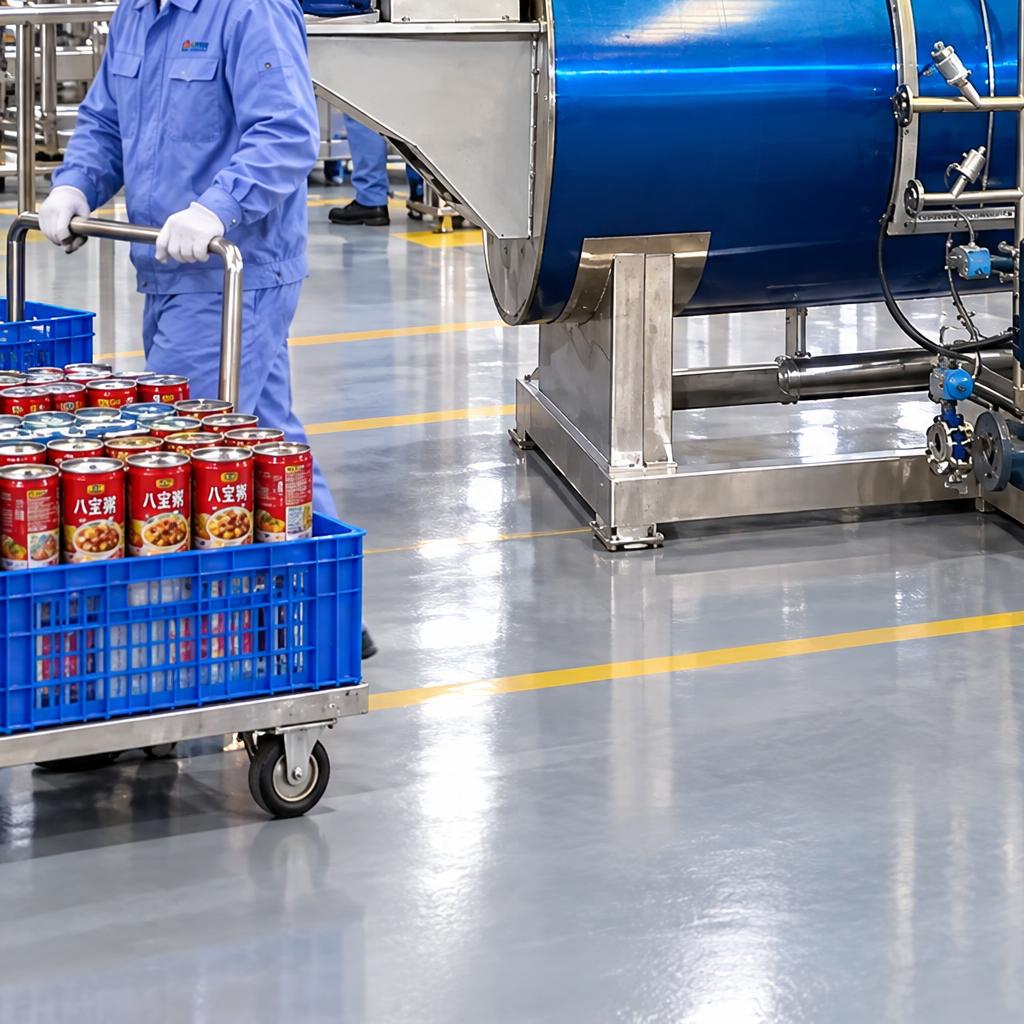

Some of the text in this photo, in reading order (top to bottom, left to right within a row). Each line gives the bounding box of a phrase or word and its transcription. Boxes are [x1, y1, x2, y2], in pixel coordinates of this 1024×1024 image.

[143, 489, 184, 510] 八宝粥
[208, 483, 247, 503] 八宝粥
[74, 495, 116, 516] 八宝粥
